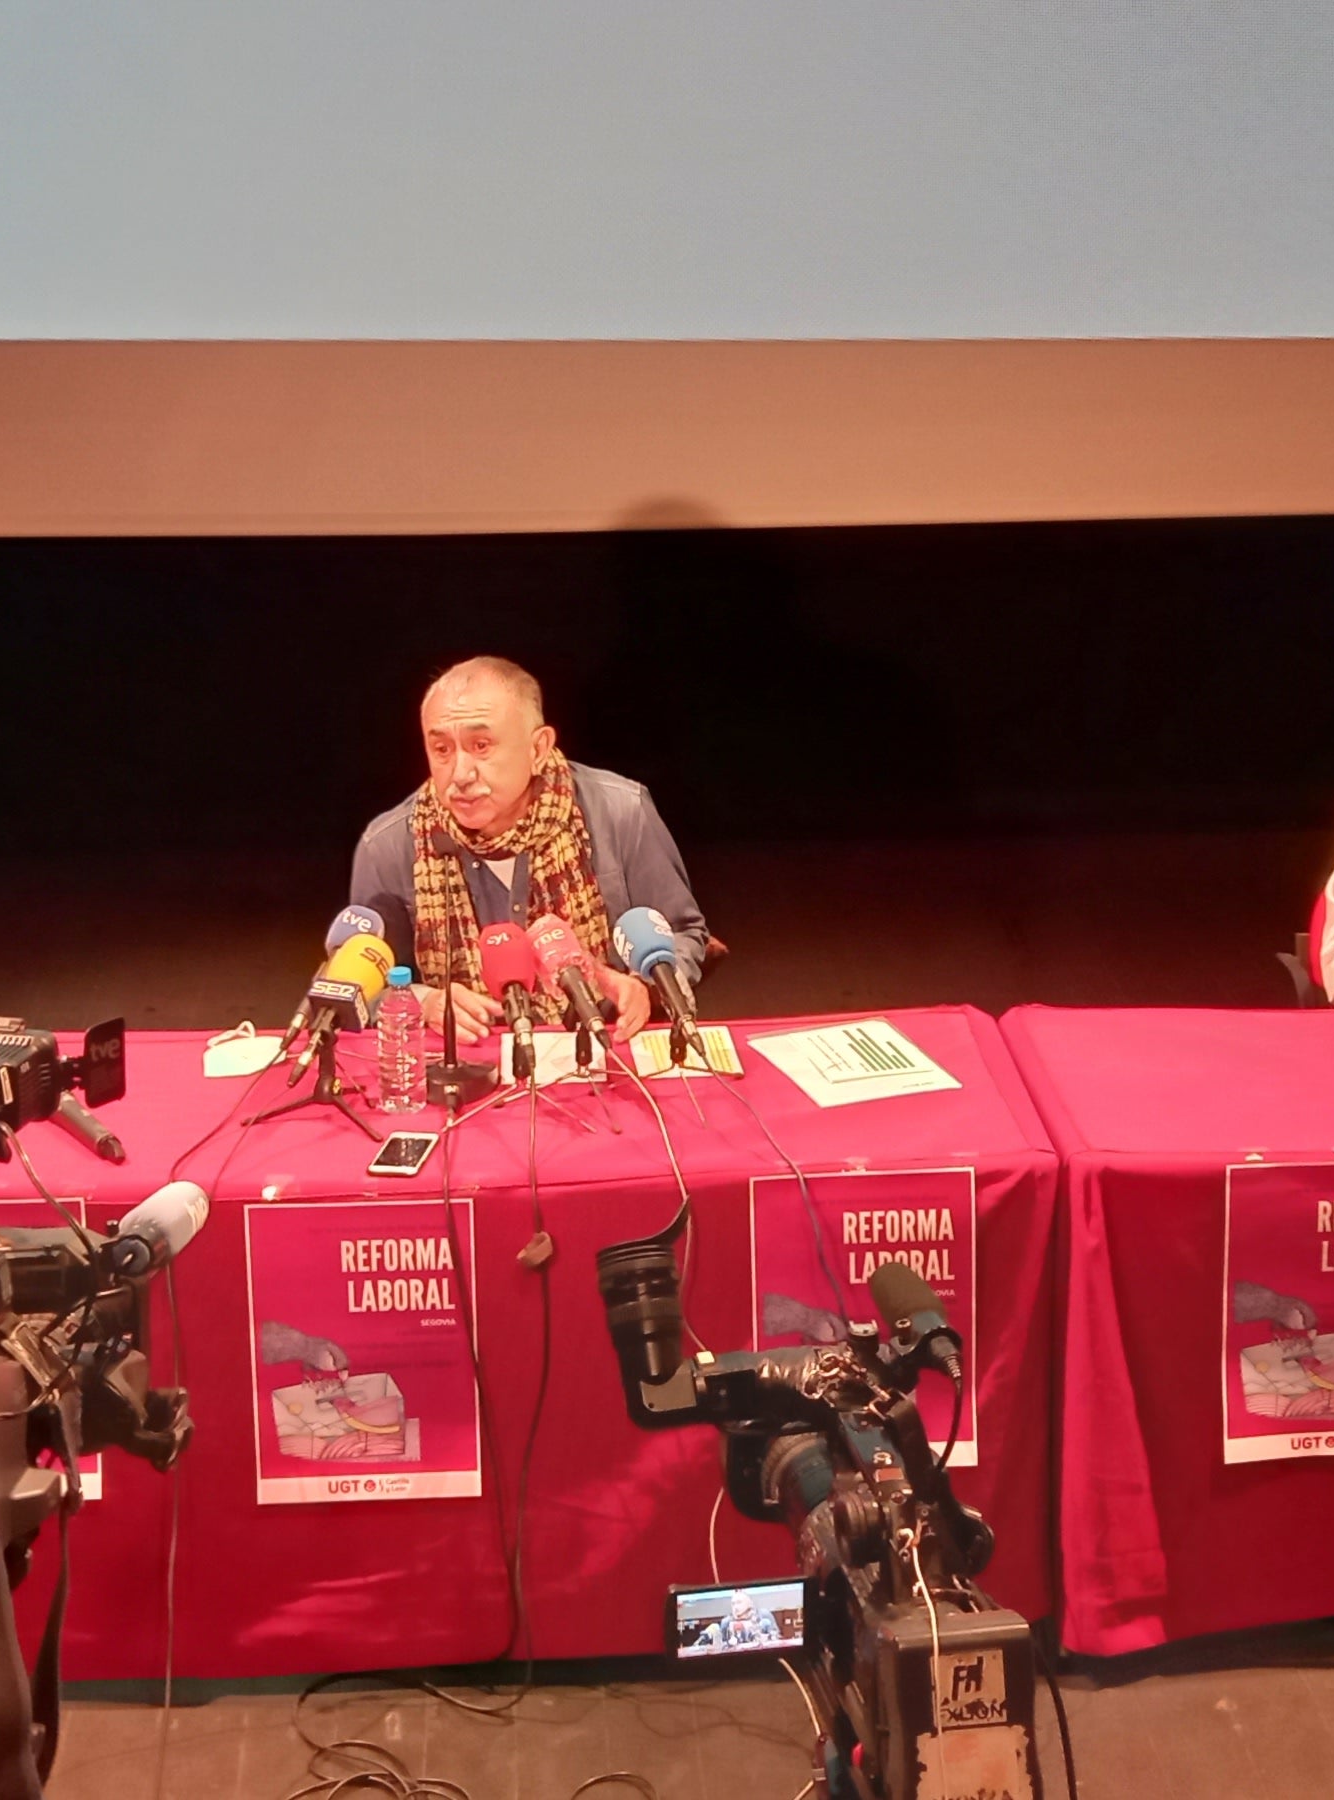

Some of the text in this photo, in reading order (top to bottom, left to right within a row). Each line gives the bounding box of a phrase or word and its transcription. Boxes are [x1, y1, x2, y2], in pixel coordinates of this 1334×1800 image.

[342, 910, 372, 933] tve
[359, 947, 390, 979] SE
[310, 981, 356, 998] SER
[90, 1038, 121, 1061] tve
[843, 1208, 954, 1244] REFORMA
[340, 1237, 454, 1272] REFORMA
[347, 1278, 456, 1313] LABORAL
[420, 1318, 456, 1326] SEGOVIA
[1290, 1436, 1322, 1450] UGT
[328, 1480, 360, 1494] UGT
